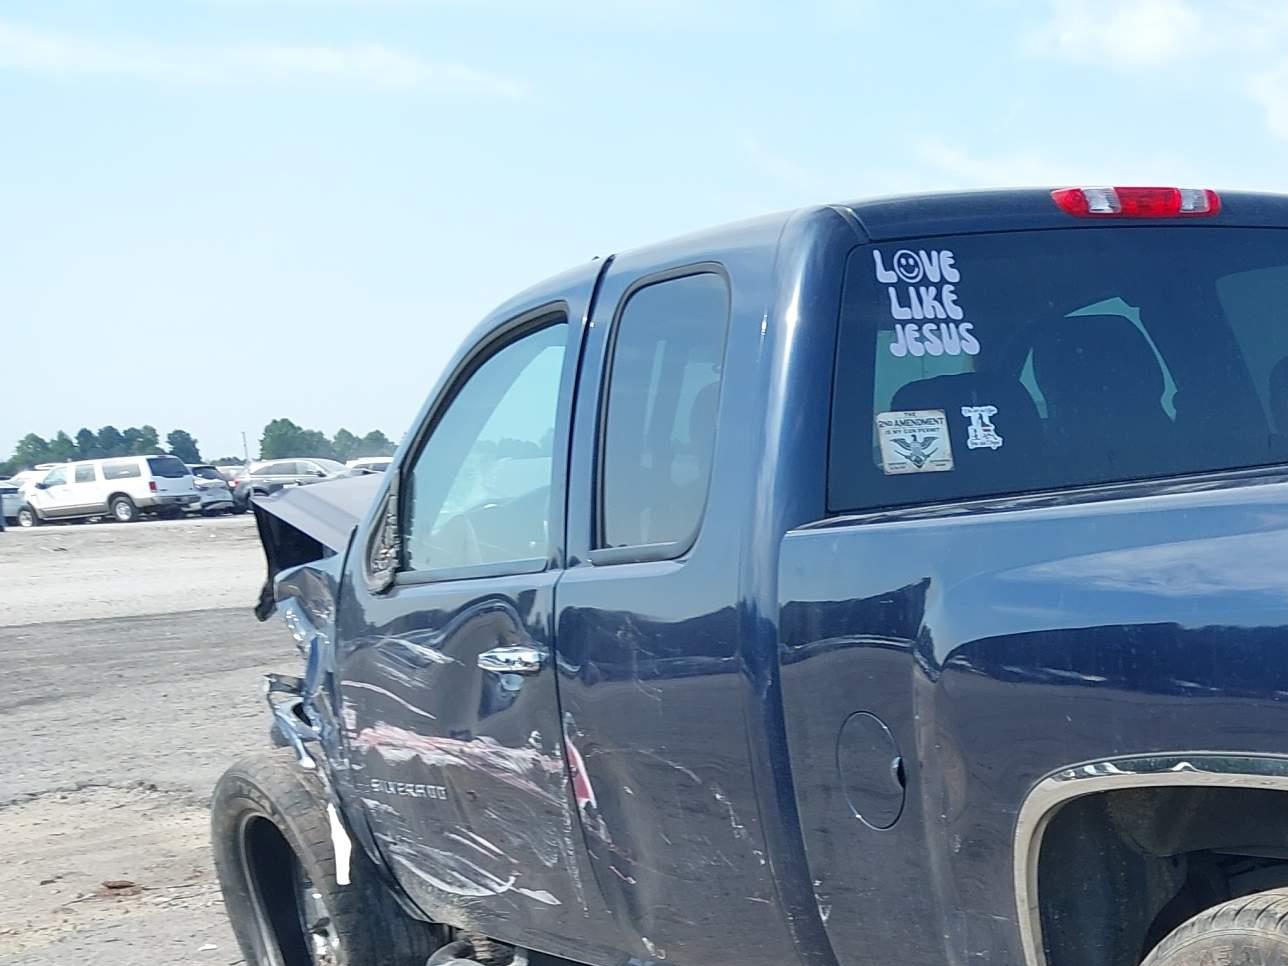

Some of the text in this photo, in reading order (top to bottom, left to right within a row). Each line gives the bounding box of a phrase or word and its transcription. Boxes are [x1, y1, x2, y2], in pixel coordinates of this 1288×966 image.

[872, 249, 961, 283] LOVE
[888, 284, 964, 320] LIKE
[889, 322, 981, 357] JESUS
